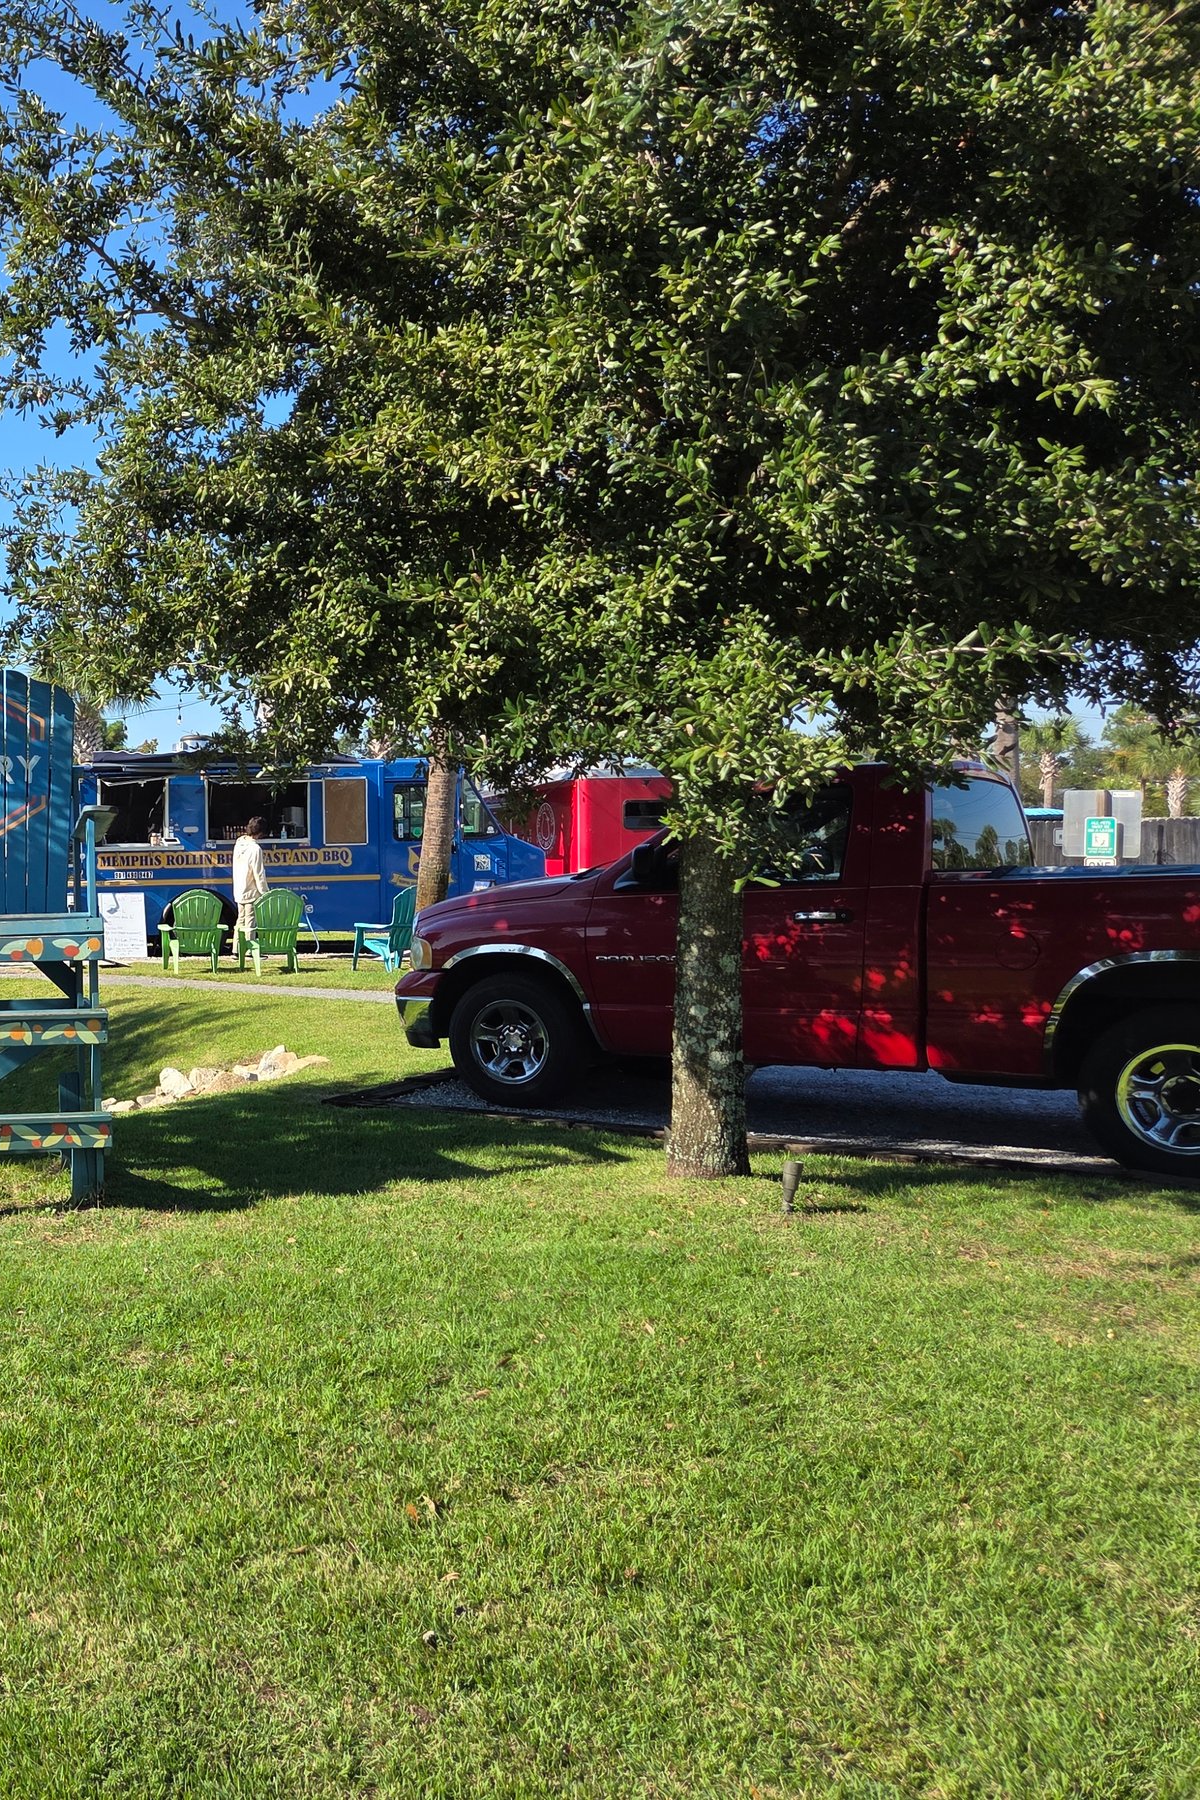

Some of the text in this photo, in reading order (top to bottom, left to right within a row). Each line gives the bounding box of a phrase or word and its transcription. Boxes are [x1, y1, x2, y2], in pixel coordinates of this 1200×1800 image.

[166, 854, 213, 866] ROLLIN
[294, 850, 318, 862] AND
[323, 850, 349, 863] BBQ
